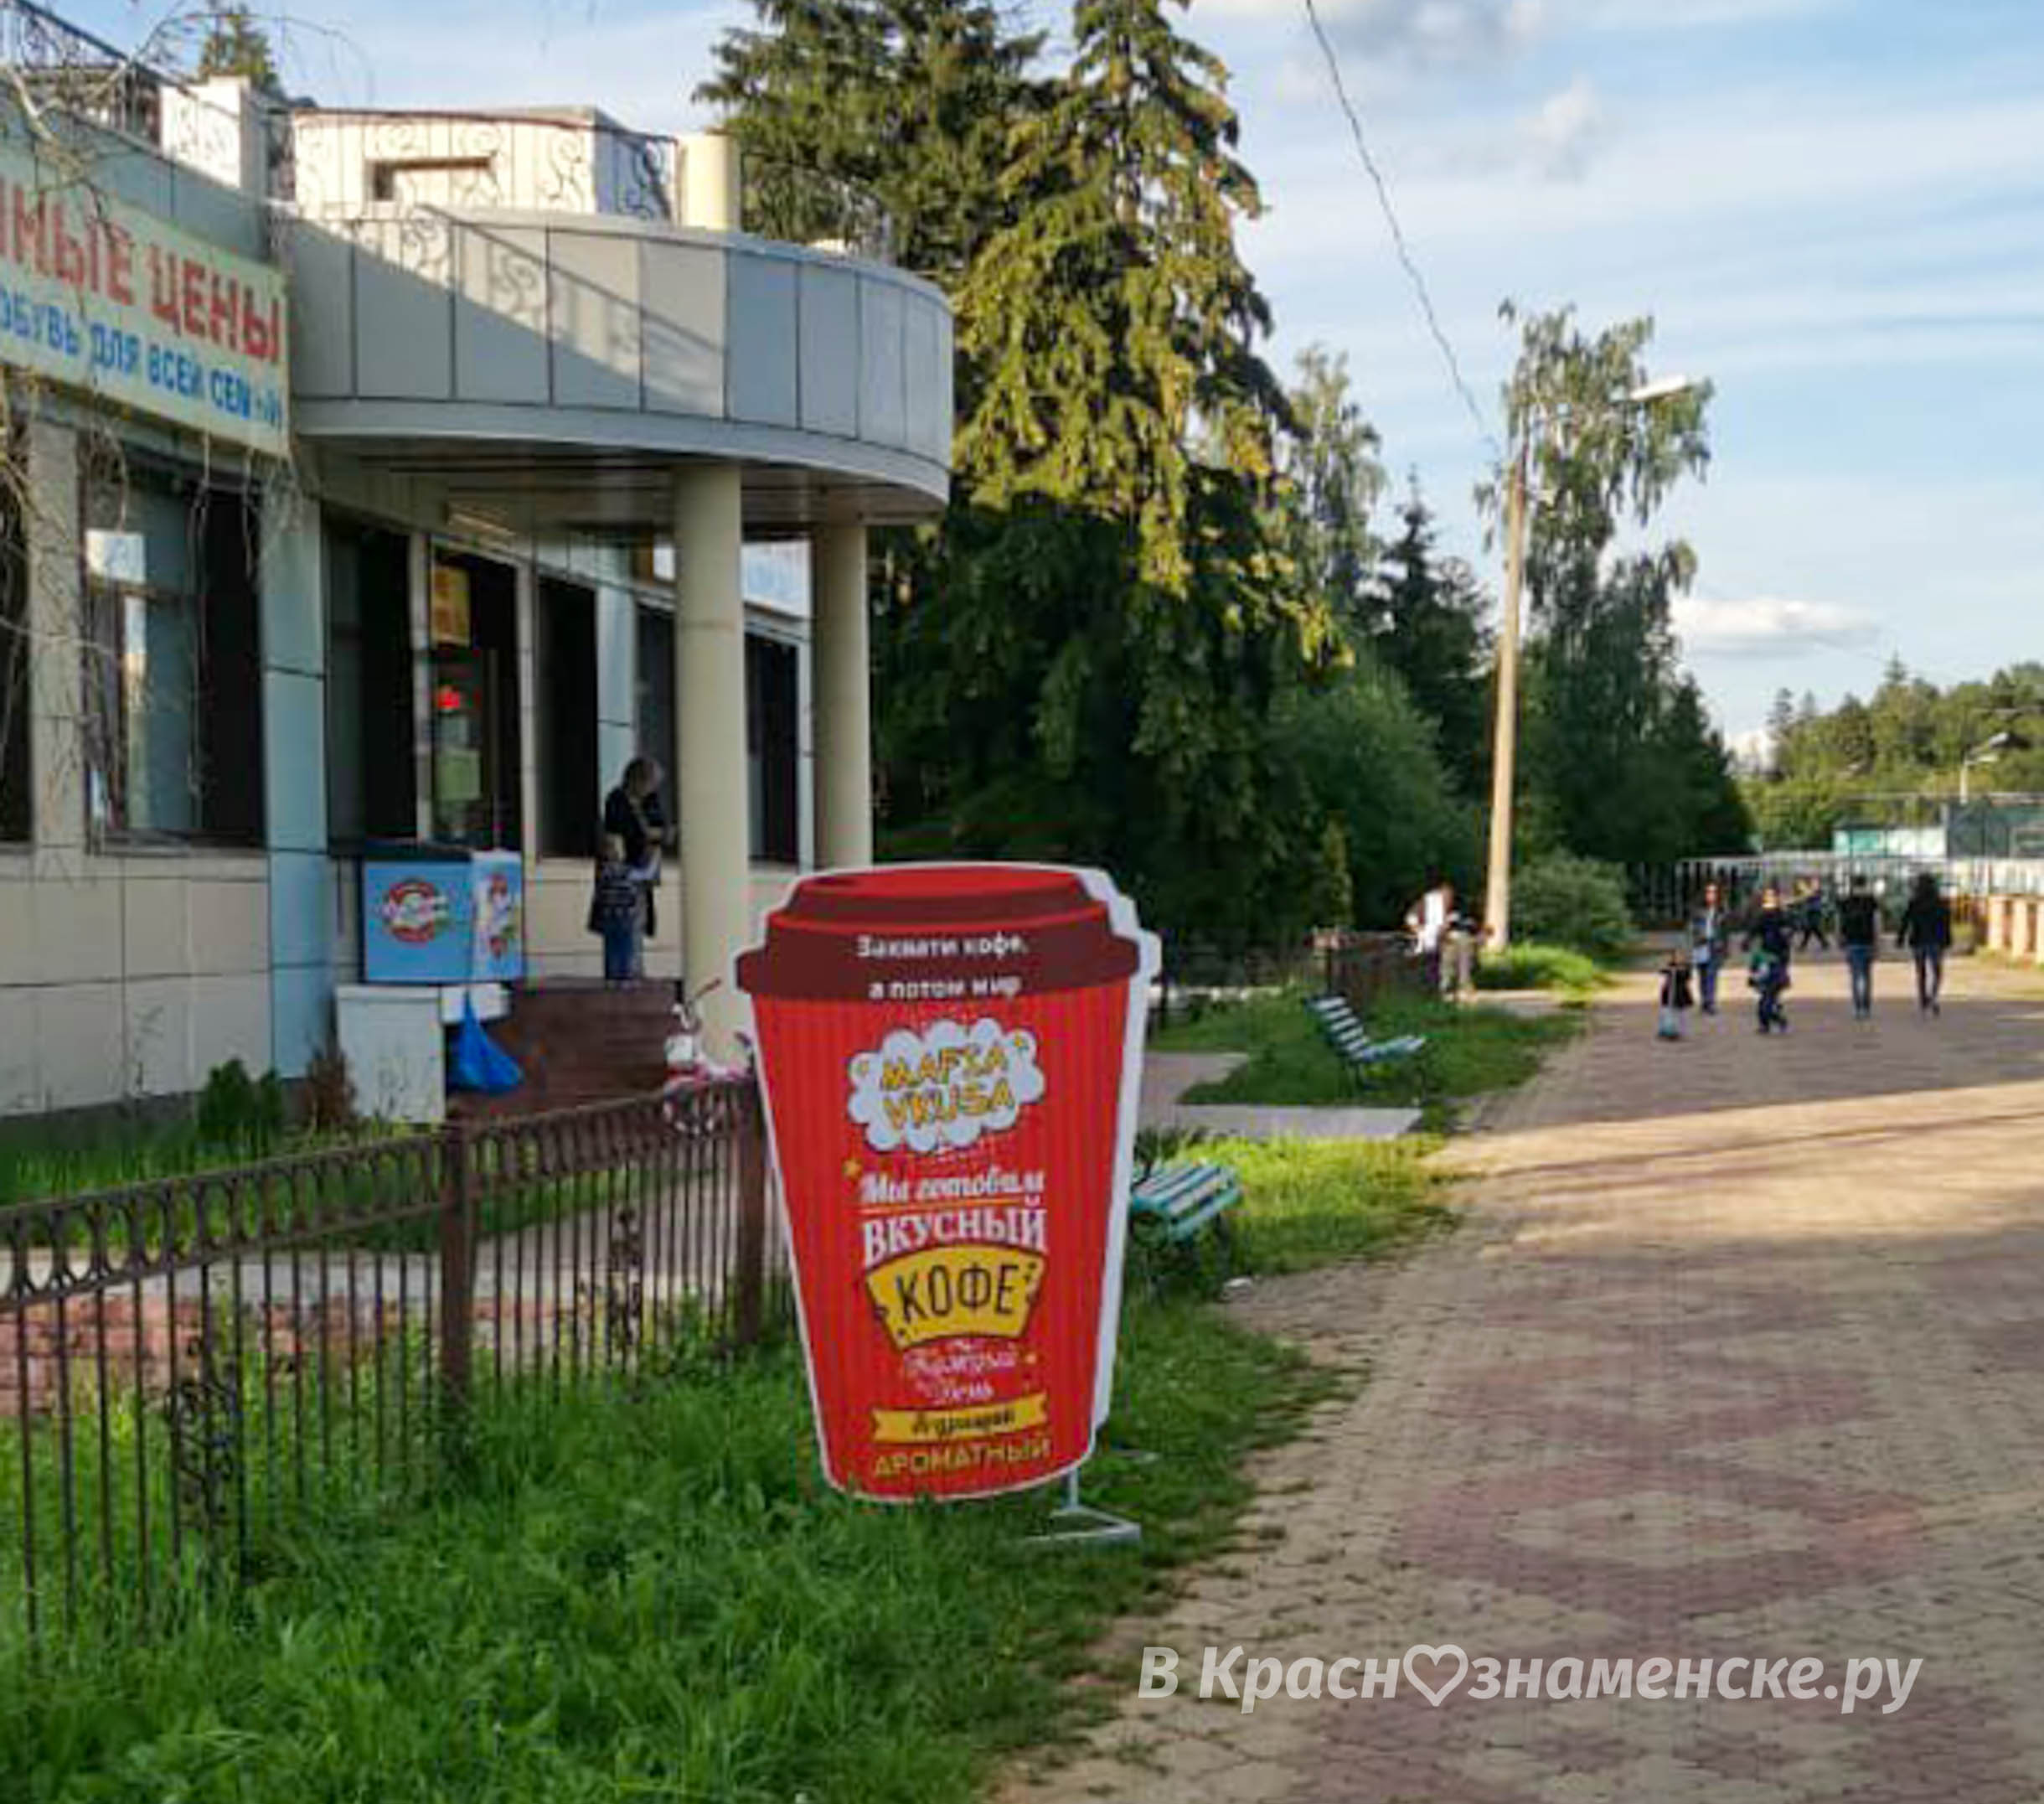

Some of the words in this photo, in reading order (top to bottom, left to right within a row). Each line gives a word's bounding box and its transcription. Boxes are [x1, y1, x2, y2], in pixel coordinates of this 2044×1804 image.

[148, 244, 280, 364] ЦЕНЫ
[90, 323, 141, 375] ДЛЯ
[210, 369, 283, 431] СЕМИ
[869, 980, 885, 1000] а
[889, 977, 966, 1000] потом
[970, 974, 1023, 1002] мир
[881, 1078, 1017, 1130] VKUSA
[860, 1173, 910, 1204] Мы
[916, 1167, 1046, 1203] готовим
[863, 1195, 1048, 1268] ВКУСНЫЙ
[896, 1260, 1020, 1324] КОФЕ
[874, 1434, 1053, 1477] АРОМАТНЫЙ
